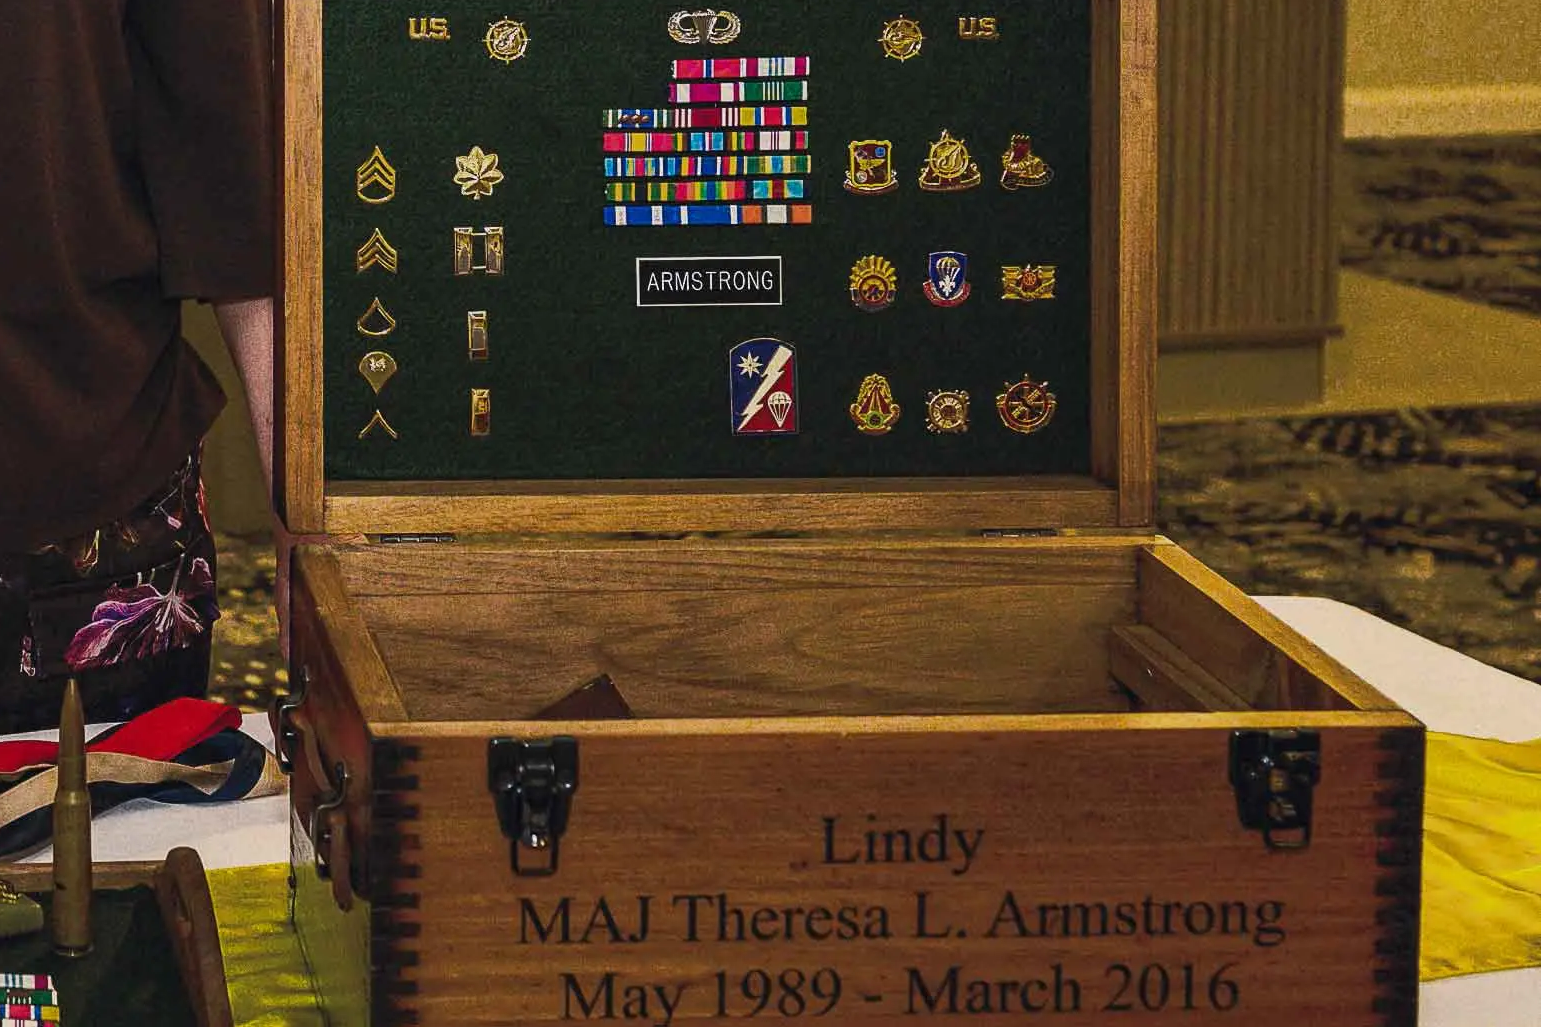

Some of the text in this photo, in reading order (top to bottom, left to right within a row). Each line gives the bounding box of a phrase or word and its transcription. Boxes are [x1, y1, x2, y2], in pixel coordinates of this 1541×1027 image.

[647, 270, 774, 292] ARMSTRONG
[820, 813, 985, 875] Lindy
[518, 890, 1287, 947] MAJ Theresa L. Armstrong
[560, 962, 1241, 1027] May 1989 - March 2016
